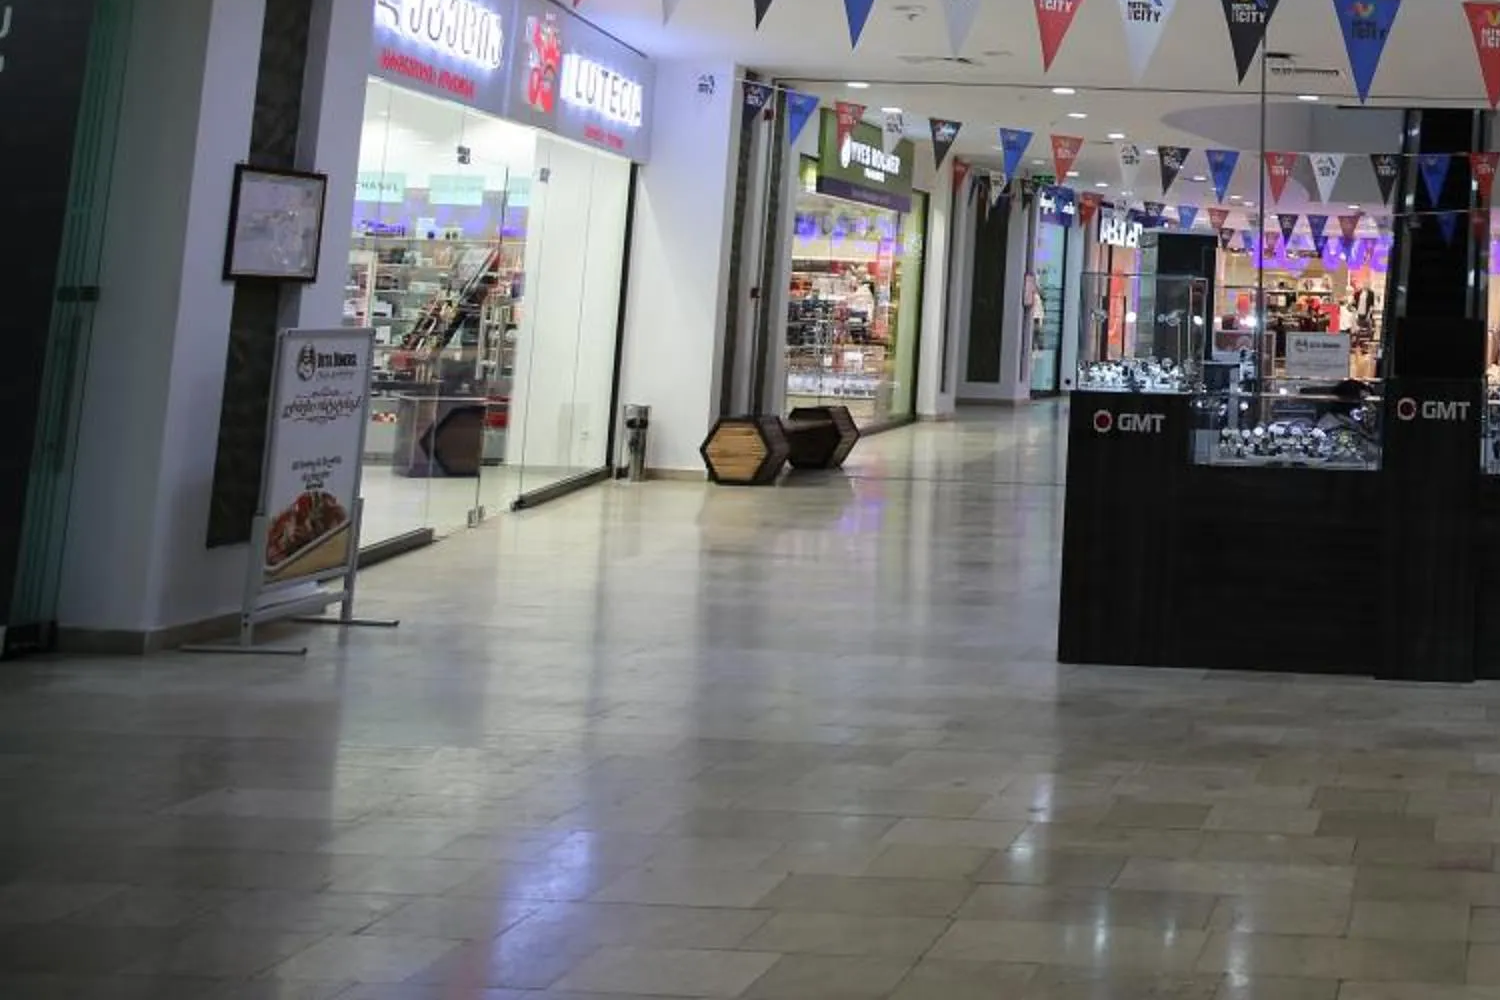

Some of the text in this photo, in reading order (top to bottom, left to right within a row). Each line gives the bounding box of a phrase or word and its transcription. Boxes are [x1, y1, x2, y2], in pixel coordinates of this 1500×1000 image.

[1045, 1, 1073, 13] CITY
[1134, 10, 1160, 23] CITY
[1239, 12, 1266, 23] CITY
[1422, 400, 1470, 421] GMT
[1117, 412, 1167, 434] GMT
